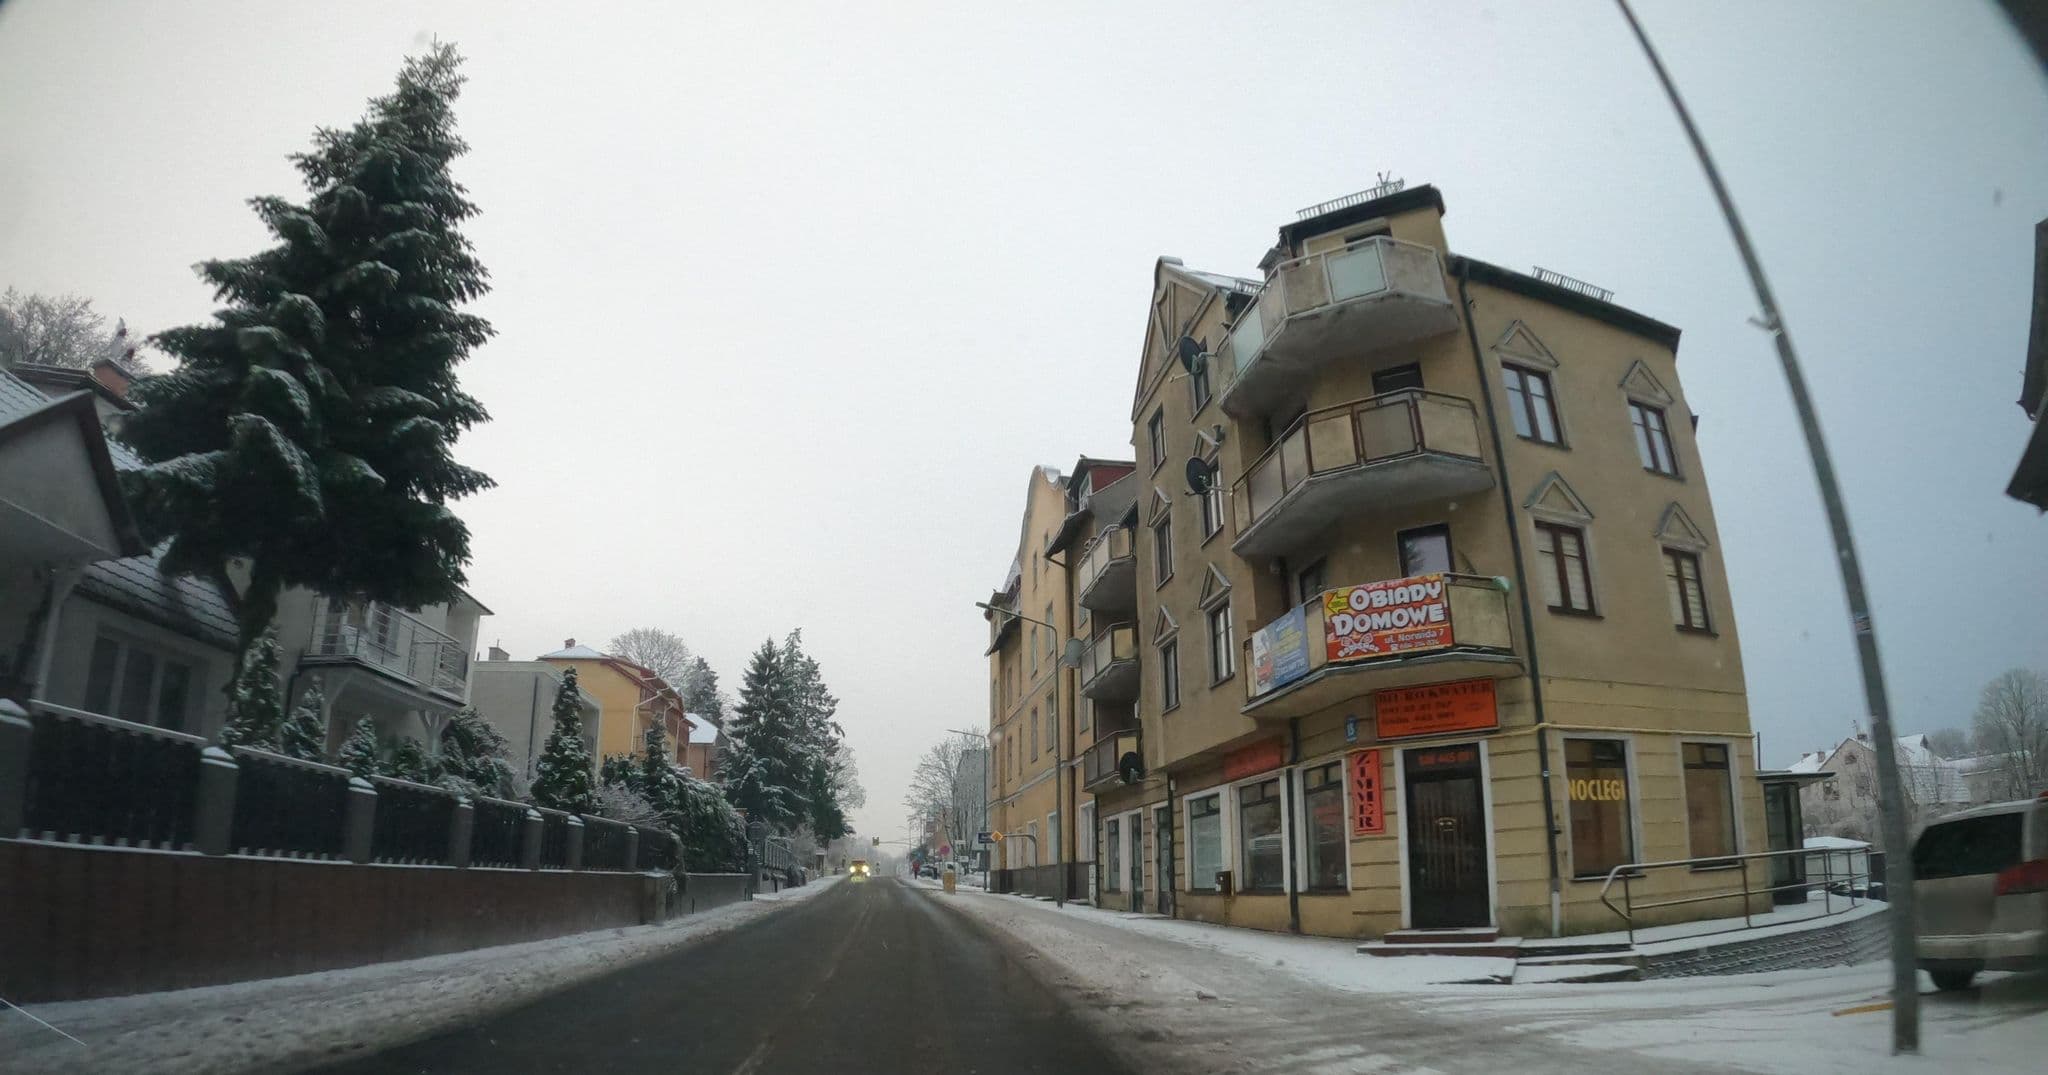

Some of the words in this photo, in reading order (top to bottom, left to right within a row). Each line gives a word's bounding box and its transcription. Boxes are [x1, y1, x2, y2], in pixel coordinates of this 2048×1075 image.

[1349, 581, 1442, 611] OBIADY
[1331, 603, 1445, 636] DOMOWE
[1356, 753, 1374, 828] ZIMMER
[1568, 779, 1626, 801] NOCLEGI
